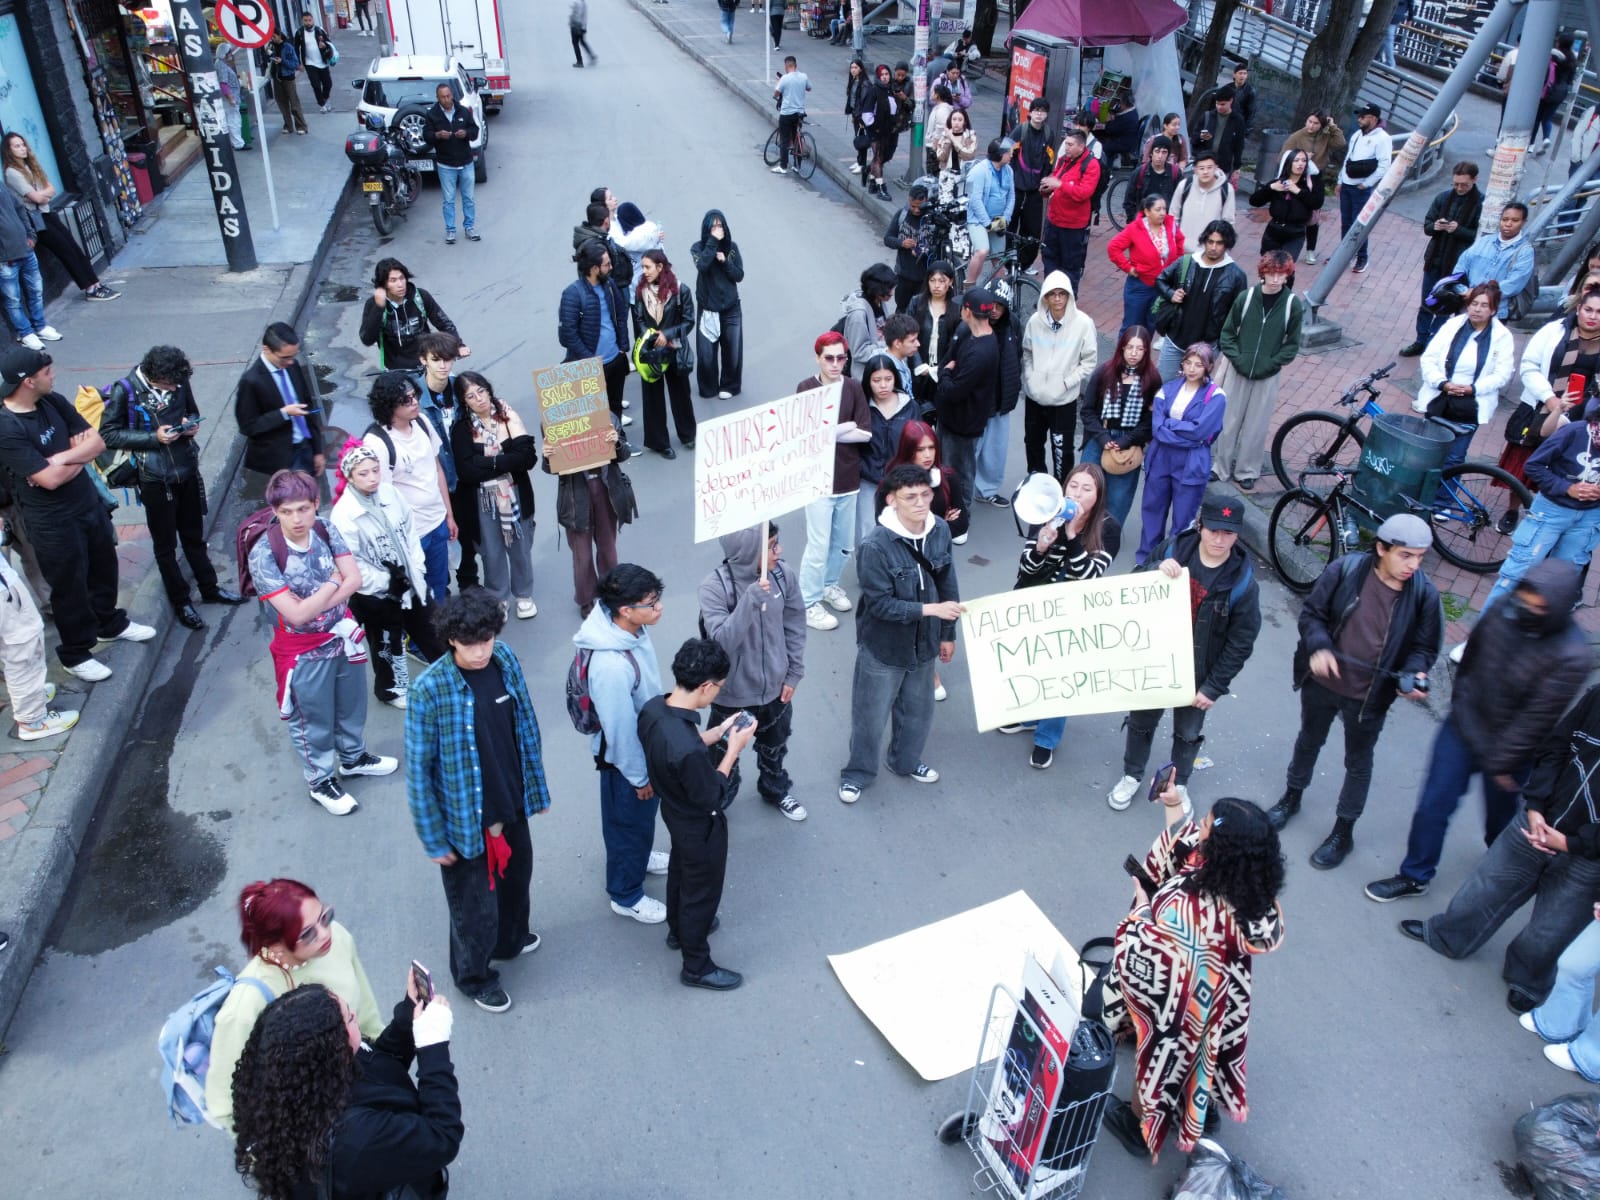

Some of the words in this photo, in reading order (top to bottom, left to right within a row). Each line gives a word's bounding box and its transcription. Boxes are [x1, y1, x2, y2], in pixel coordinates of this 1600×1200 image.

[173, 0, 203, 57] AS
[581, 376, 601, 396] DE
[704, 410, 767, 468] SENTIRSE
[702, 491, 727, 519] NO
[1083, 590, 1113, 611] NOS
[1120, 580, 1170, 605] ESTÁN
